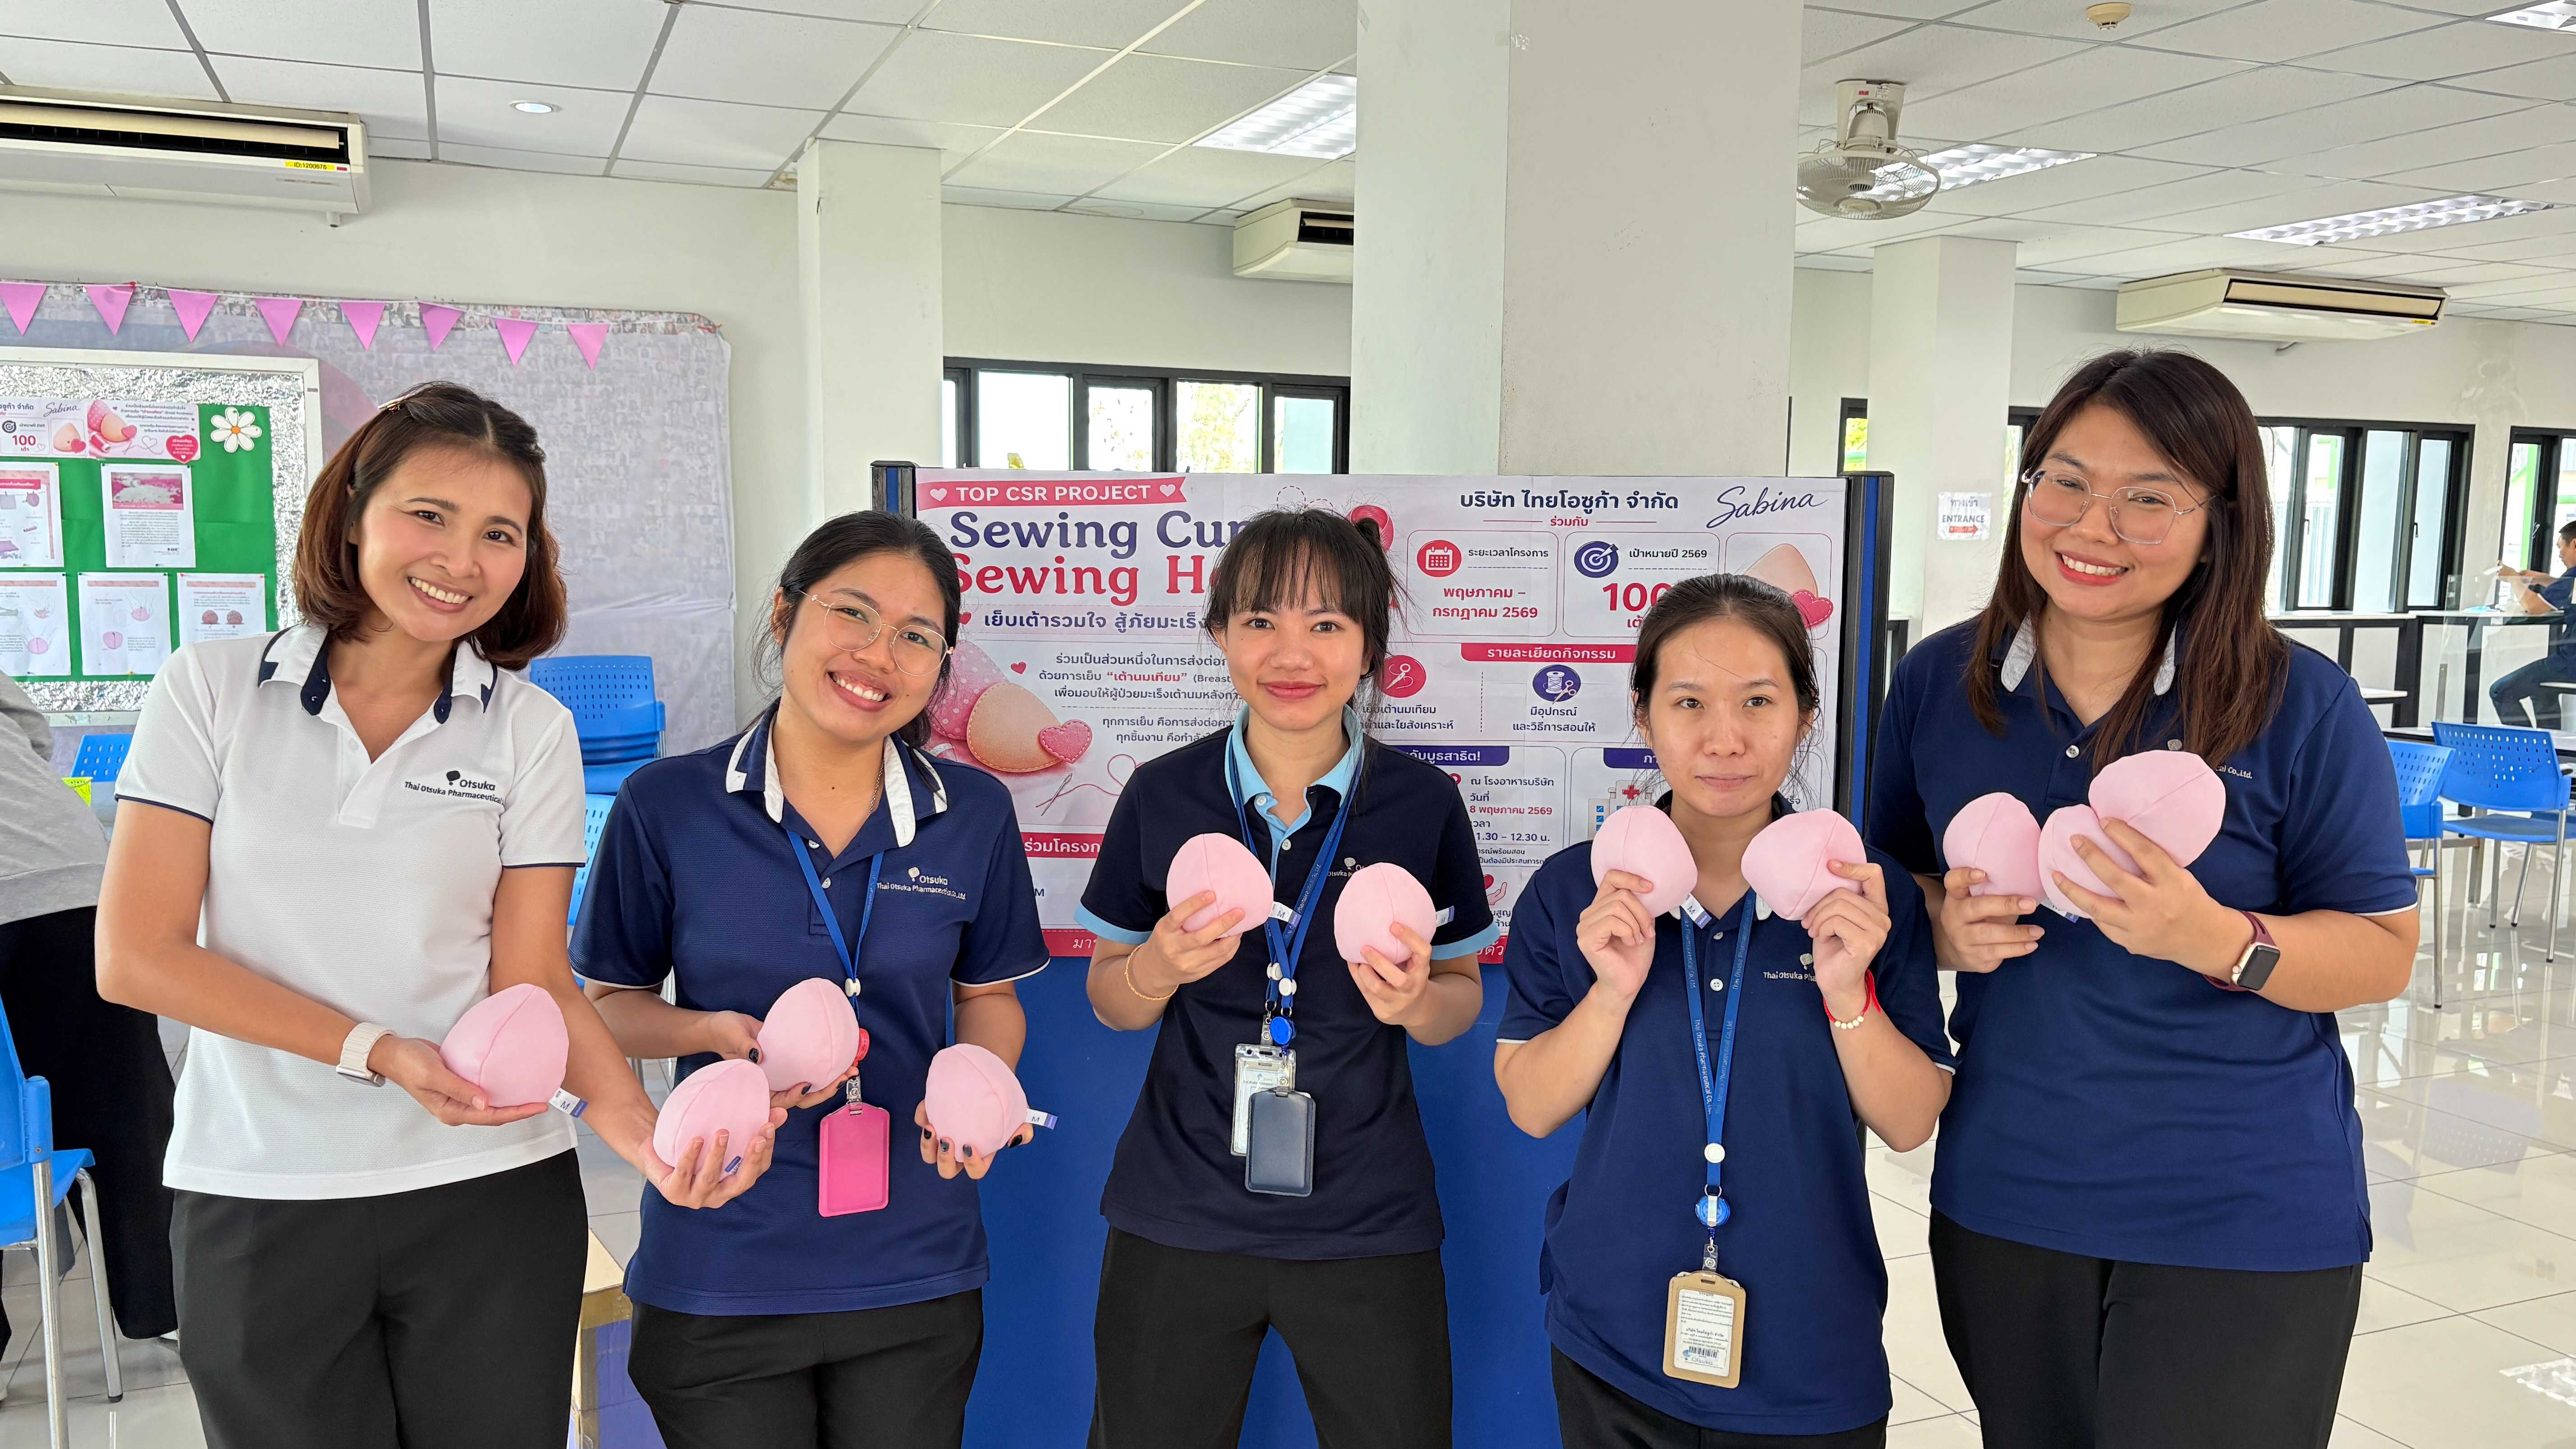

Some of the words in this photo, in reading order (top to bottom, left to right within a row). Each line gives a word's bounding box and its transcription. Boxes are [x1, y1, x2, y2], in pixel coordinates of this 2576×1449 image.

[43, 402, 79, 417] Sabina
[12, 435, 36, 446] 100
[956, 487, 998, 501] TOP
[1006, 486, 1047, 501] CSR
[1055, 485, 1151, 500] PROJECT
[1460, 491, 1514, 508] บริษัท
[1523, 490, 1619, 515] ไทยโอซูก้า
[1627, 492, 1679, 509] จำกัด
[1706, 486, 1828, 529] Sabina
[1550, 515, 1588, 526] ร่วมกับ
[1942, 515, 1985, 523] ENTRANCE
[951, 511, 1137, 559] Sewing
[1468, 547, 1549, 559] ระยะเวลาโครงการ
[1629, 548, 1679, 559] เป้าหมายปี
[1681, 549, 1707, 558] 2569
[952, 553, 1139, 606] Sewing
[1443, 587, 1513, 601] พฤษภาคม
[1432, 606, 1498, 620] กรกฎาคม
[1502, 607, 1538, 618] 2569
[984, 611, 1107, 628] เย็บเต้ารวมใจ
[1039, 670, 1101, 681] ด้วยการเย็บ
[1531, 706, 1578, 718] มีอุปกรณ์
[1103, 717, 1153, 727] ทุกการเย็บ
[1513, 722, 1596, 732] และวิธีการสอนให้
[1116, 731, 1163, 742] ทุกชิ้นงาน
[460, 779, 496, 791] Otsuka
[1484, 776, 1554, 786] โรงอาหารบริษัท
[405, 782, 420, 790] Thai
[421, 786, 446, 795] Otsuka
[1470, 791, 1490, 801] วันที่
[1479, 807, 1525, 815] พฤษภาคม
[920, 875, 948, 885] Otsuka
[1687, 905, 1695, 914] M
[1763, 971, 1778, 979] Thai
[1779, 971, 1803, 980] Otsuka
[560, 1101, 570, 1110] M
